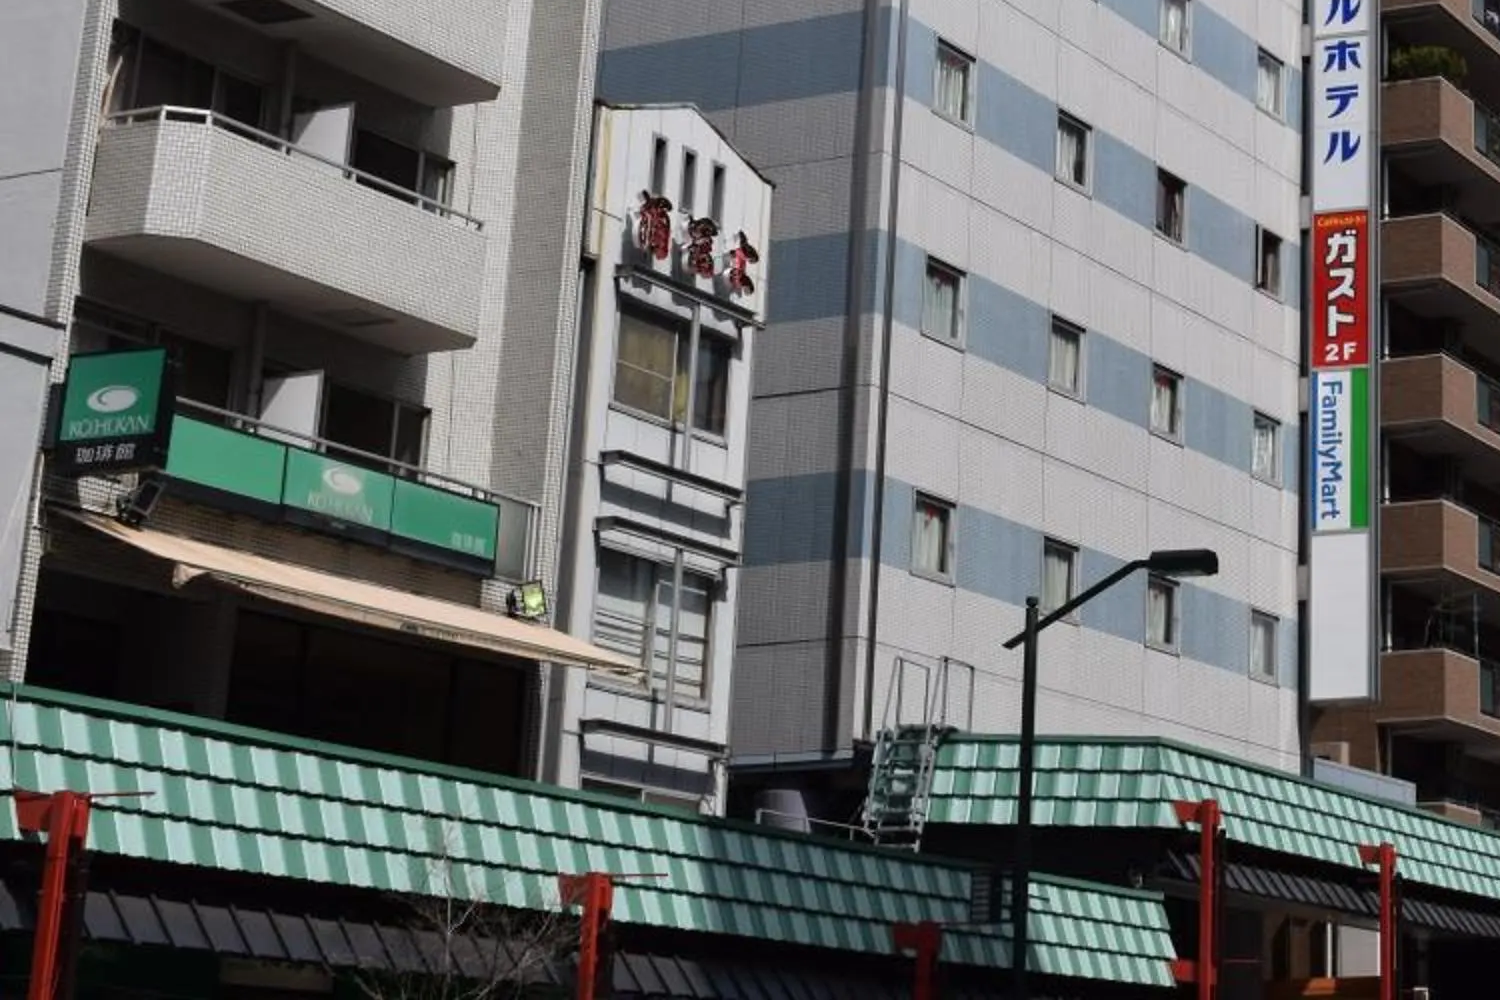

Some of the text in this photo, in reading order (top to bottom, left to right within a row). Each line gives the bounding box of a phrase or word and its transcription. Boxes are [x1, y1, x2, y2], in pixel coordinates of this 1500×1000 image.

[1325, 229, 1357, 337] ガスト
[1325, 341, 1357, 362] 2F
[1318, 380, 1343, 520] FamilyMart
